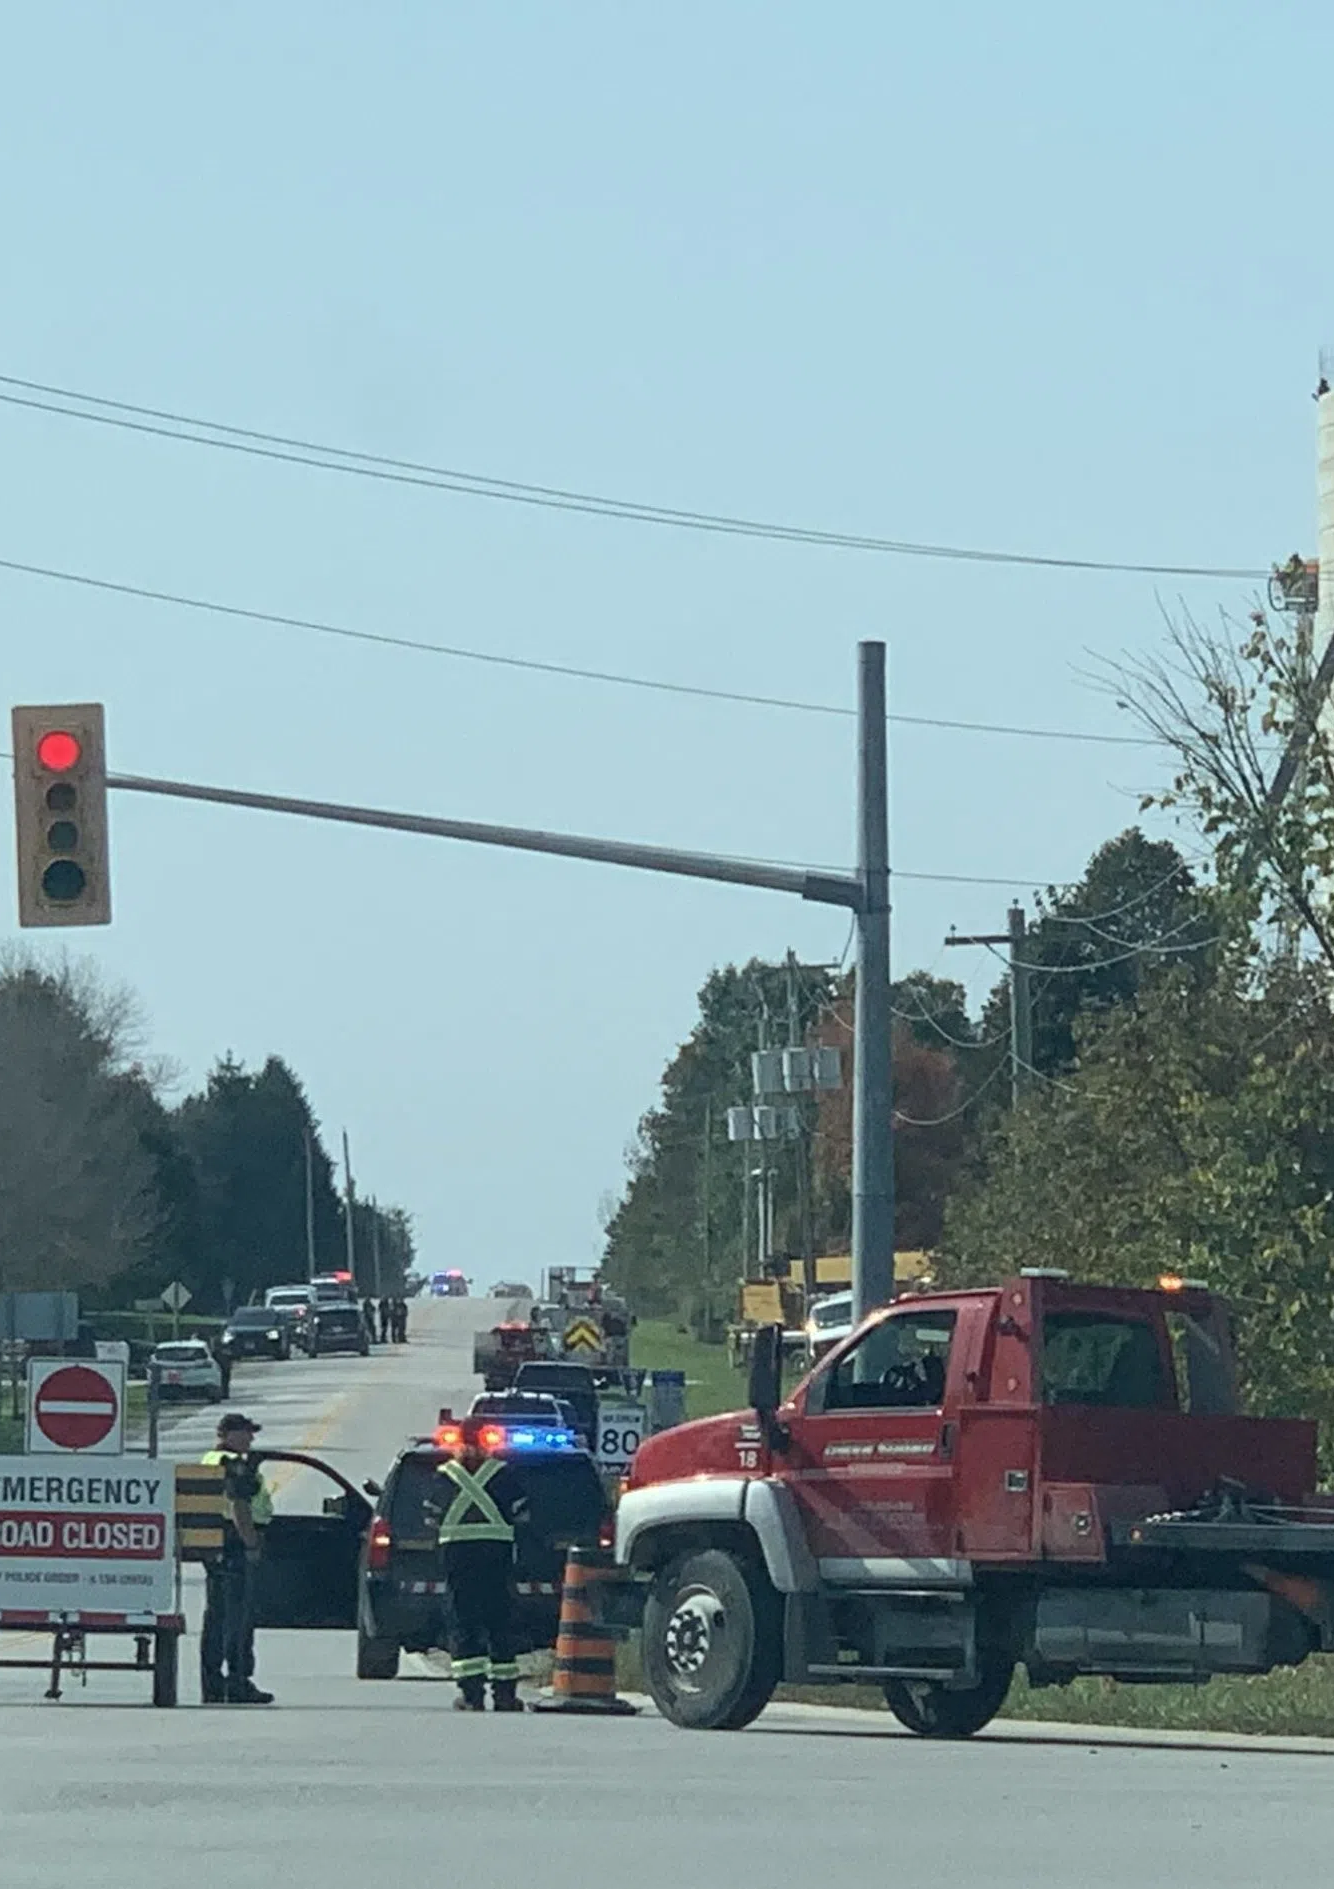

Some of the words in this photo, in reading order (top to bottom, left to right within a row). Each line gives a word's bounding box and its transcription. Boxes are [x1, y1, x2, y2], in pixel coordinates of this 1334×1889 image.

[601, 1428, 640, 1455] 80
[738, 1450, 758, 1469] 18
[62, 1521, 160, 1550] CLOSED
